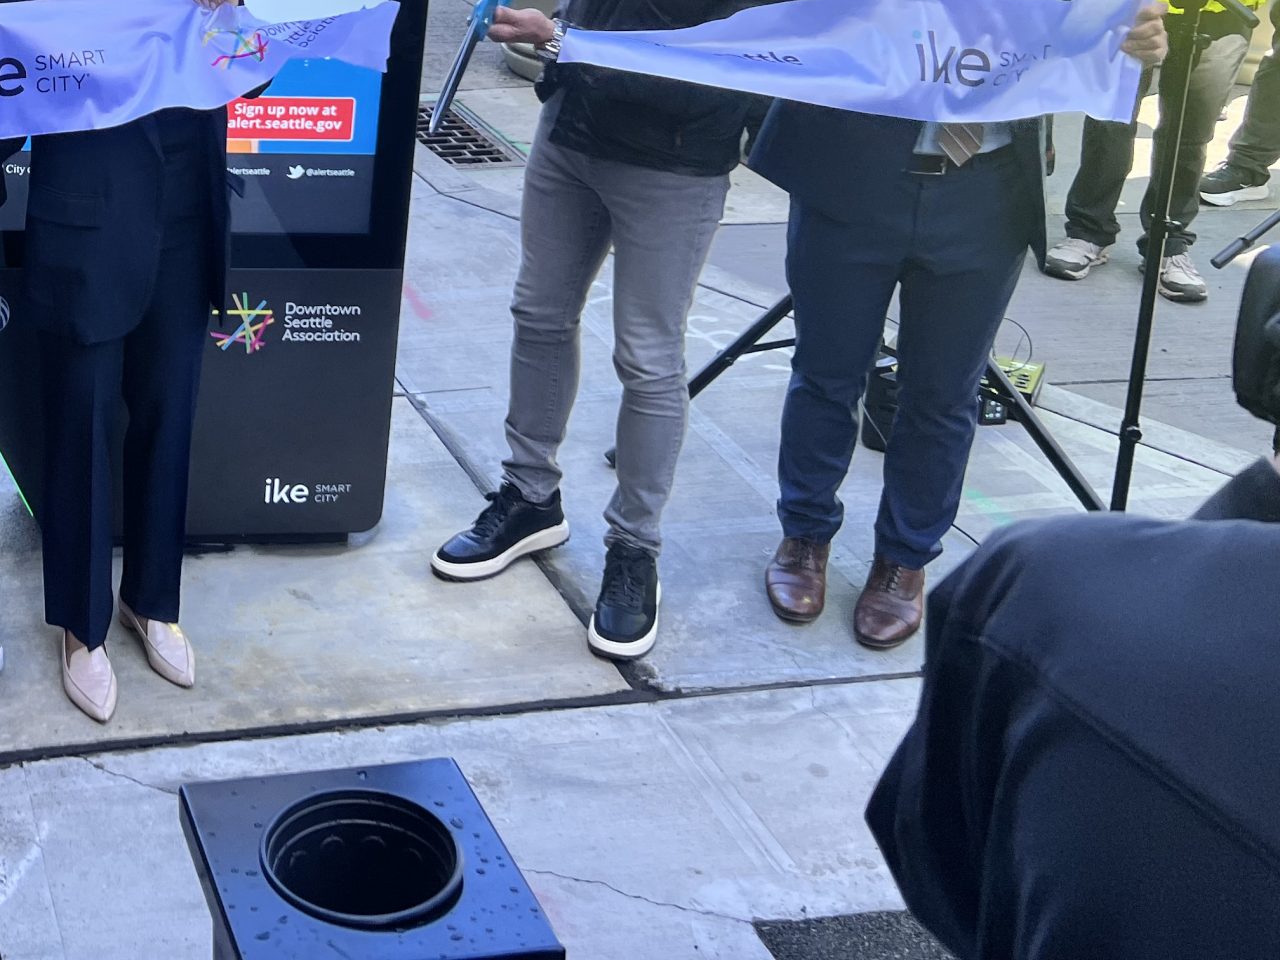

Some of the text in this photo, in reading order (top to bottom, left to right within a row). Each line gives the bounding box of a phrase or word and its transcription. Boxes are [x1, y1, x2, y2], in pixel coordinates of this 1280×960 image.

[34, 49, 106, 71] SMART
[911, 29, 991, 87] ike
[36, 74, 86, 93] CITY
[234, 103, 337, 118] Sign up now at
[228, 117, 342, 133] alert.seattle.gov
[5, 164, 26, 176] City
[306, 168, 355, 177] @alertseattle
[285, 302, 361, 315] Downtown
[284, 316, 333, 329] Seattle
[282, 329, 361, 342] Association
[265, 478, 310, 504] ike
[315, 484, 352, 494] SMART
[314, 494, 339, 502] CITY
